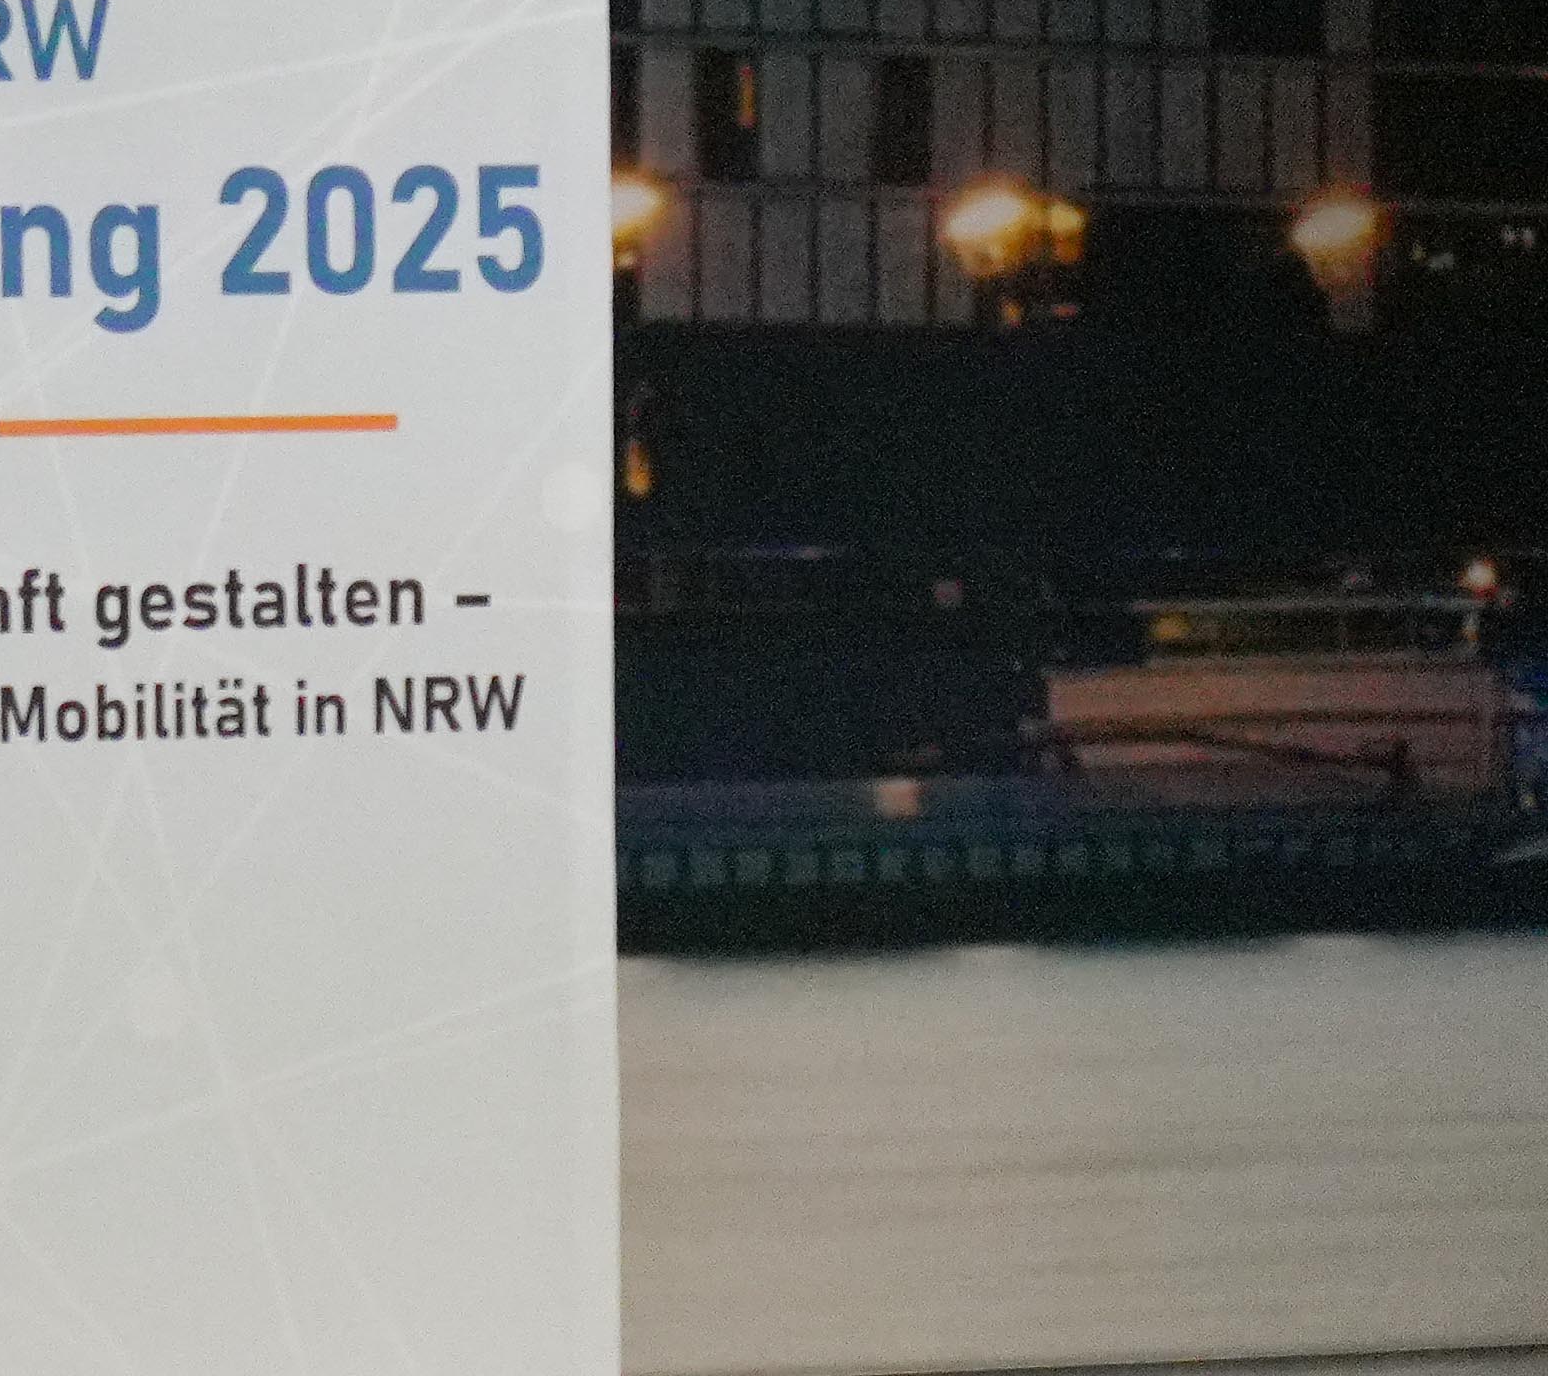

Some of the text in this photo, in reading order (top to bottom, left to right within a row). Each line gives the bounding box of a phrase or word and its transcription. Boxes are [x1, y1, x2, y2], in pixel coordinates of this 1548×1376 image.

[219, 165, 543, 295] 2025
[96, 564, 423, 649] gestalten
[0, 678, 269, 742] Mobilität
[297, 680, 345, 735] in
[375, 675, 524, 733] NRW
